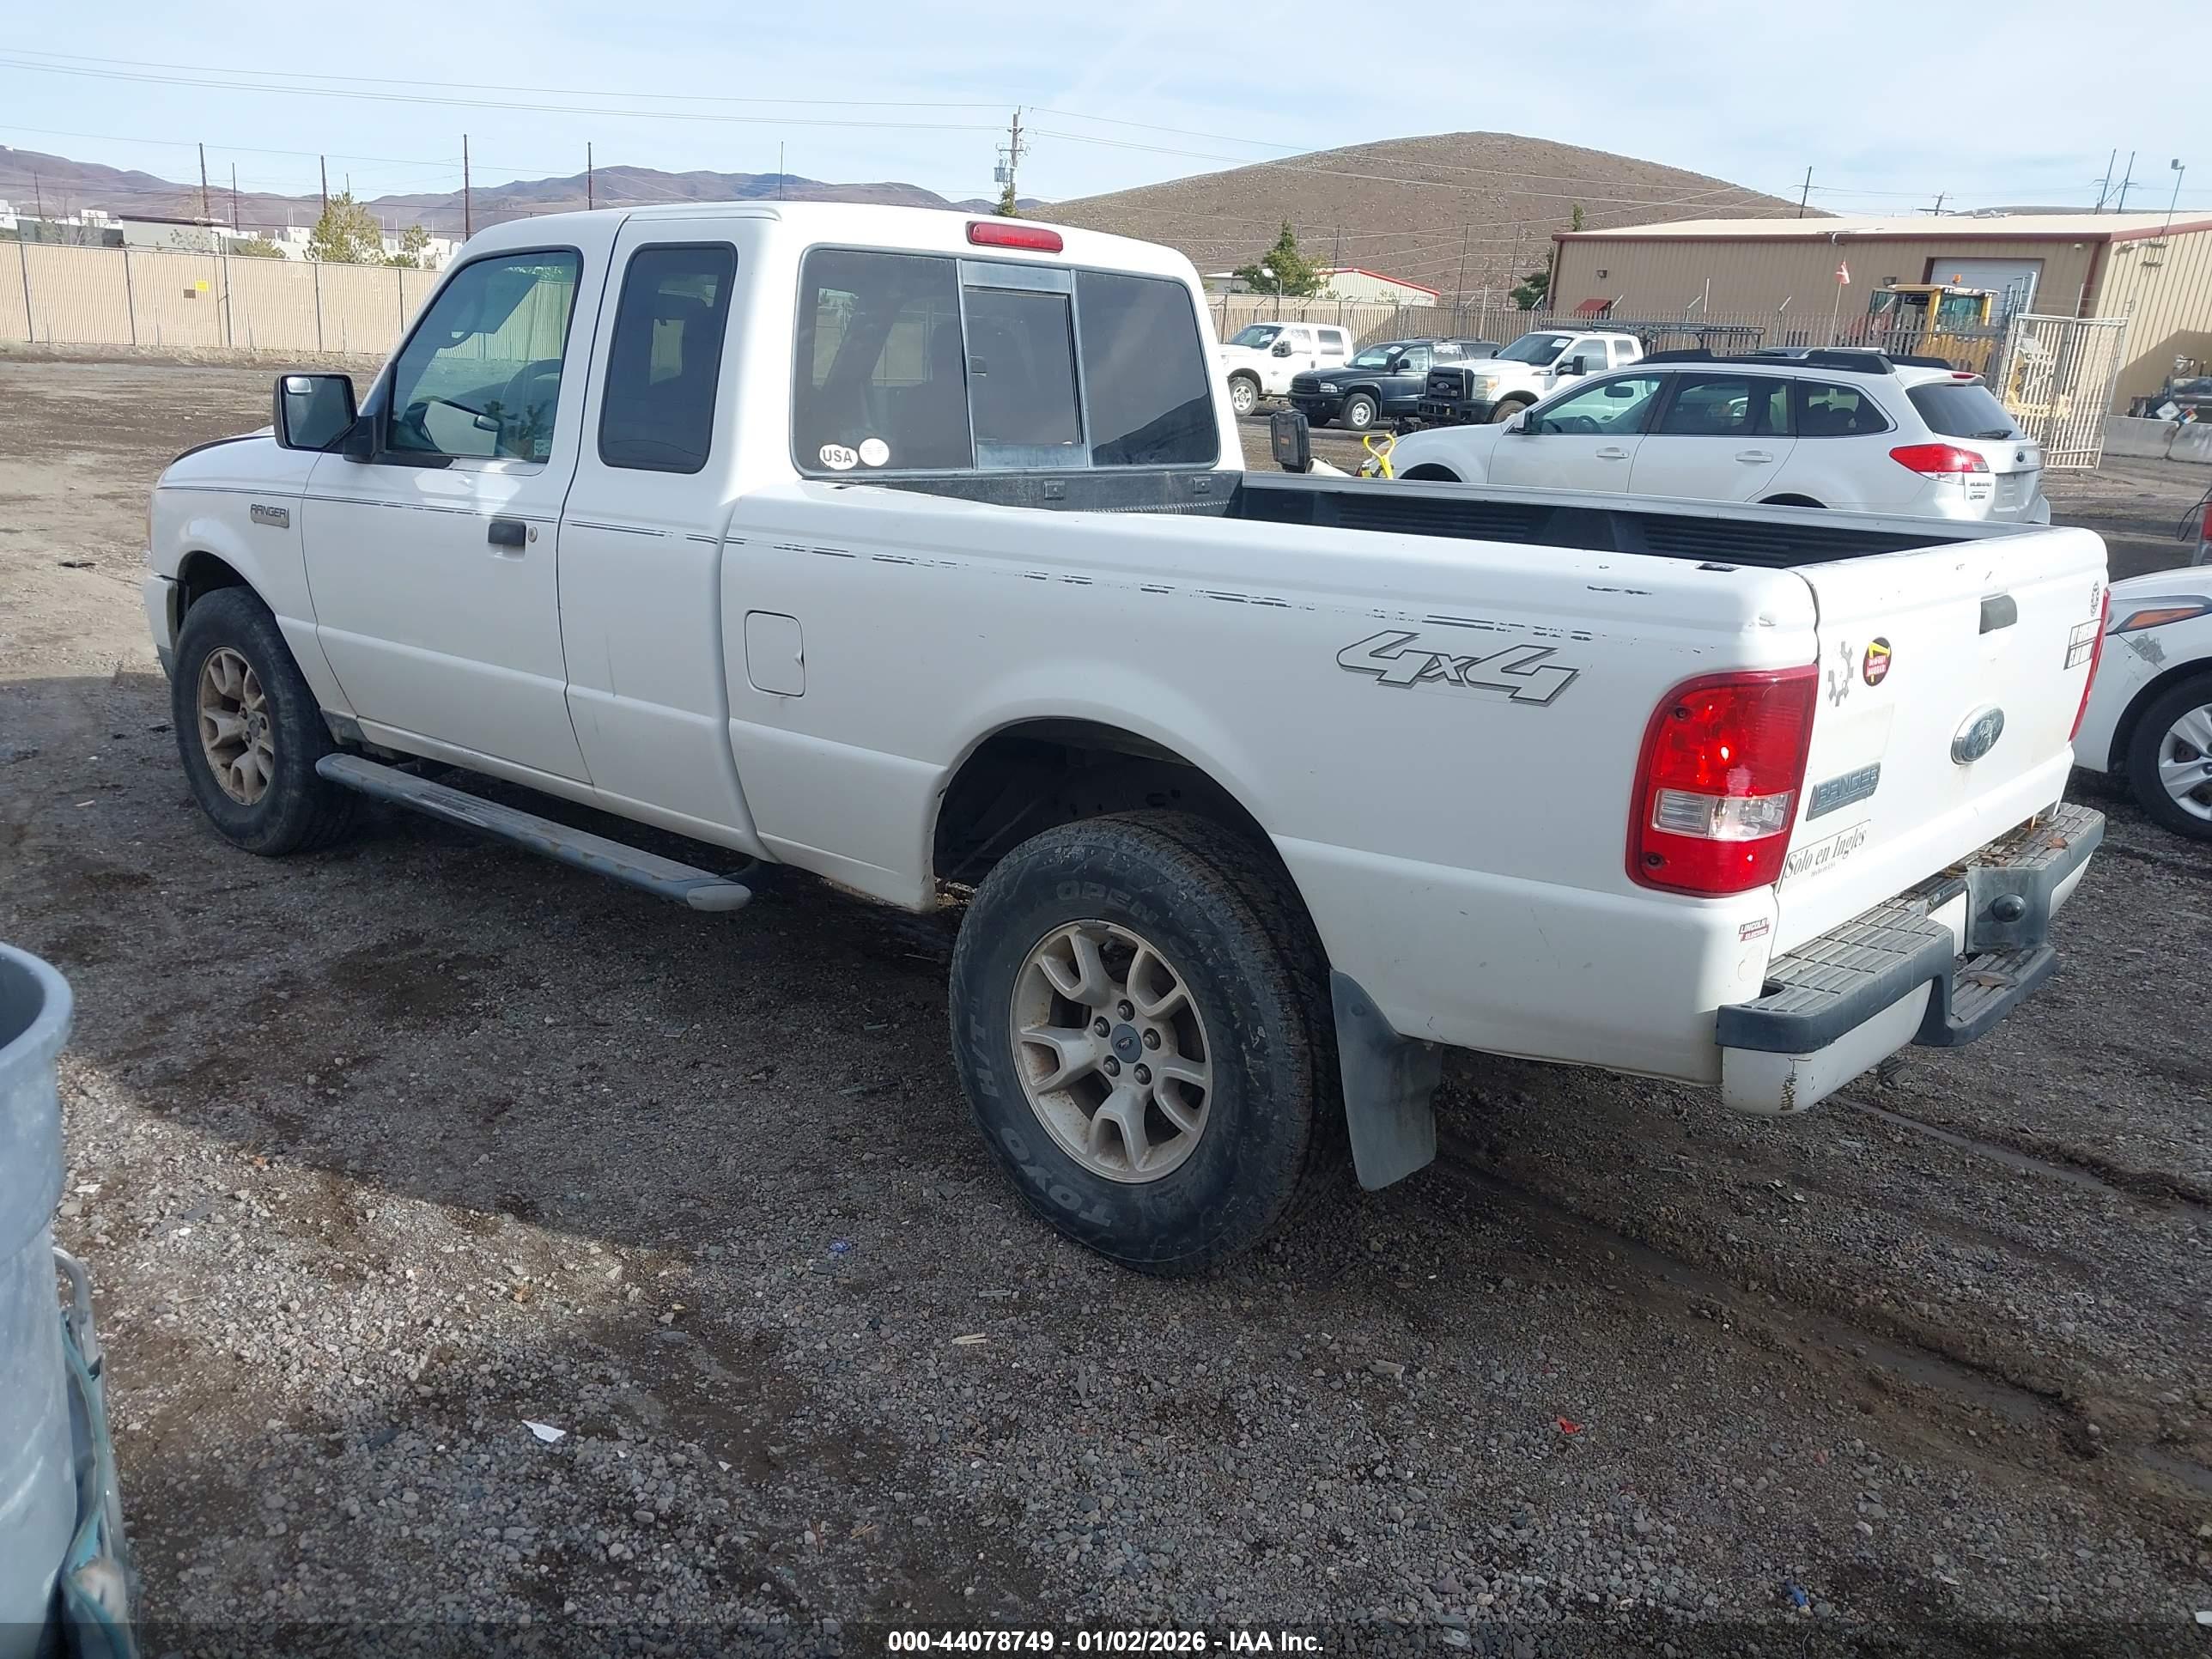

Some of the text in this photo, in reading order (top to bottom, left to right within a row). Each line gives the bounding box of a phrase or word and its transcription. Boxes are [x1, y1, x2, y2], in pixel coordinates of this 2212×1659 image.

[822, 449, 854, 464] USA
[250, 503, 287, 519] RANGER
[1336, 629, 1580, 708] 4x4
[1815, 846, 1831, 866] en
[1056, 880, 1159, 923] OPEN
[1000, 1127, 1112, 1227] TOYO
